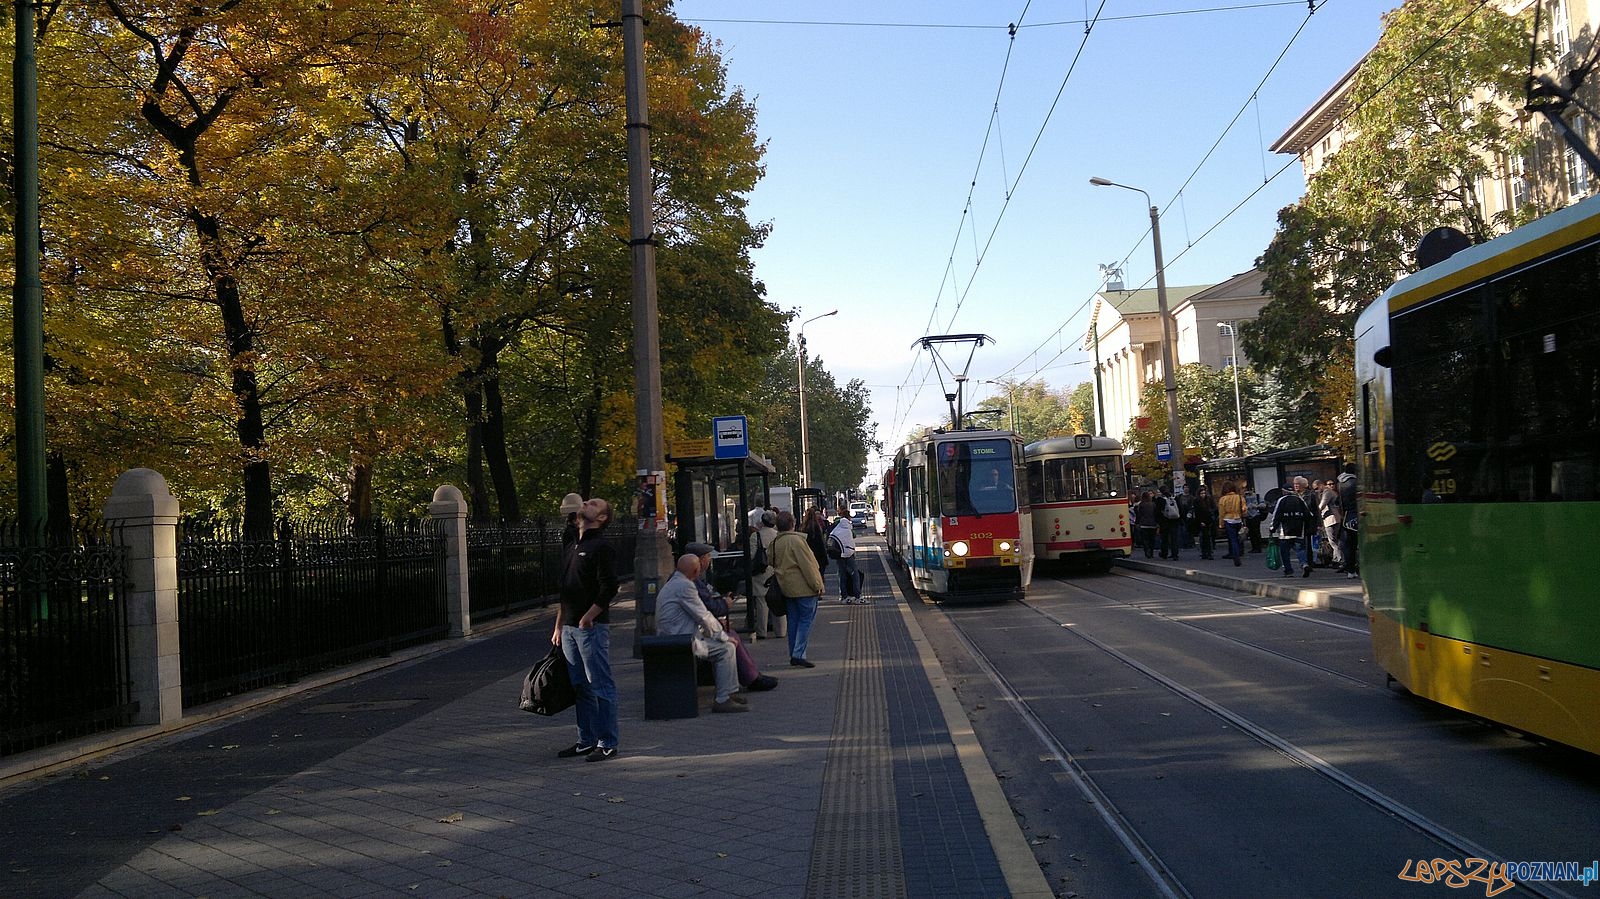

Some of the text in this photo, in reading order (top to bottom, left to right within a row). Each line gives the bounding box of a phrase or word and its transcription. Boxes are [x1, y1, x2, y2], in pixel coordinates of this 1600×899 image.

[1080, 437, 1086, 446] 9
[1431, 478, 1457, 494] 419
[970, 532, 993, 540] 302
